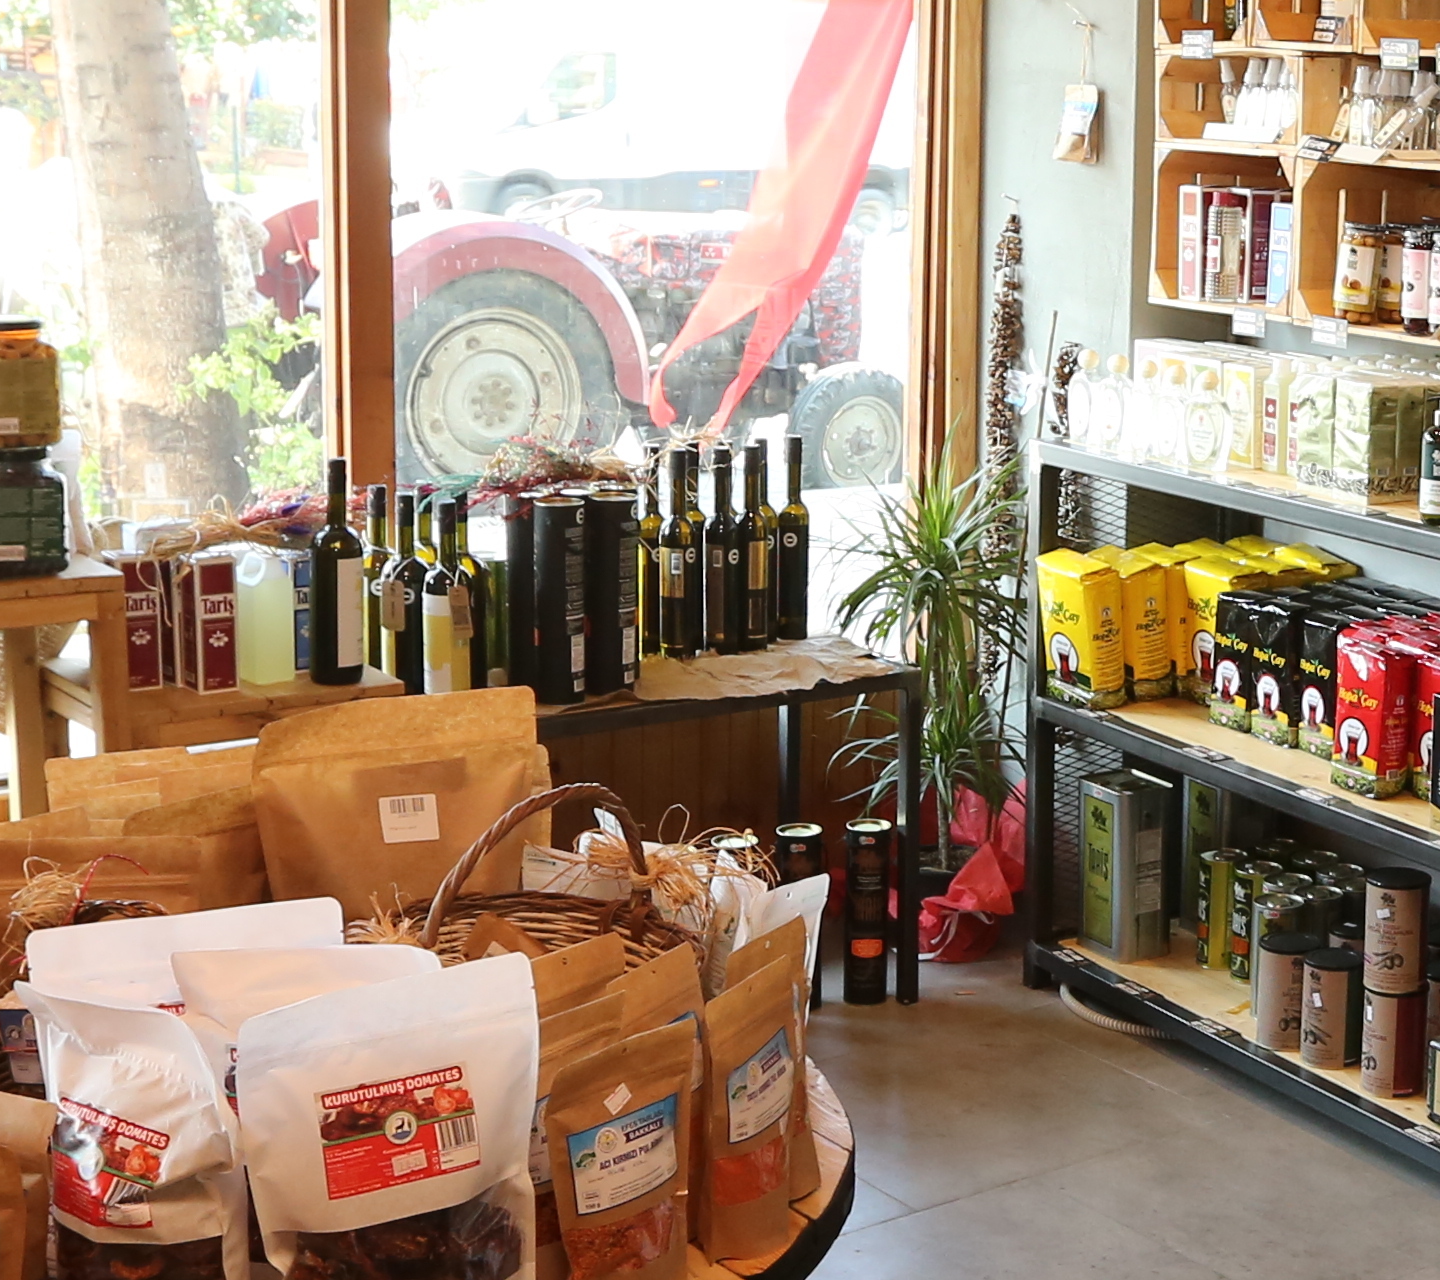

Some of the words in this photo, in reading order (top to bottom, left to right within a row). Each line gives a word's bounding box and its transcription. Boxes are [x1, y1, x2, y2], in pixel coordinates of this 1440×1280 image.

[125, 594, 157, 614] Tariş
[201, 598, 234, 615] Tariş
[1338, 687, 1359, 703] Hopa
[1358, 693, 1379, 711] Çay
[323, 1079, 405, 1109] KURUTULMUŞ
[404, 1067, 461, 1092] DOMATES
[117, 1120, 168, 1149] DOMATES
[628, 1120, 661, 1141] BAKKALI
[599, 1158, 611, 1171] ACI
[612, 1148, 638, 1168] KIRMIZI
